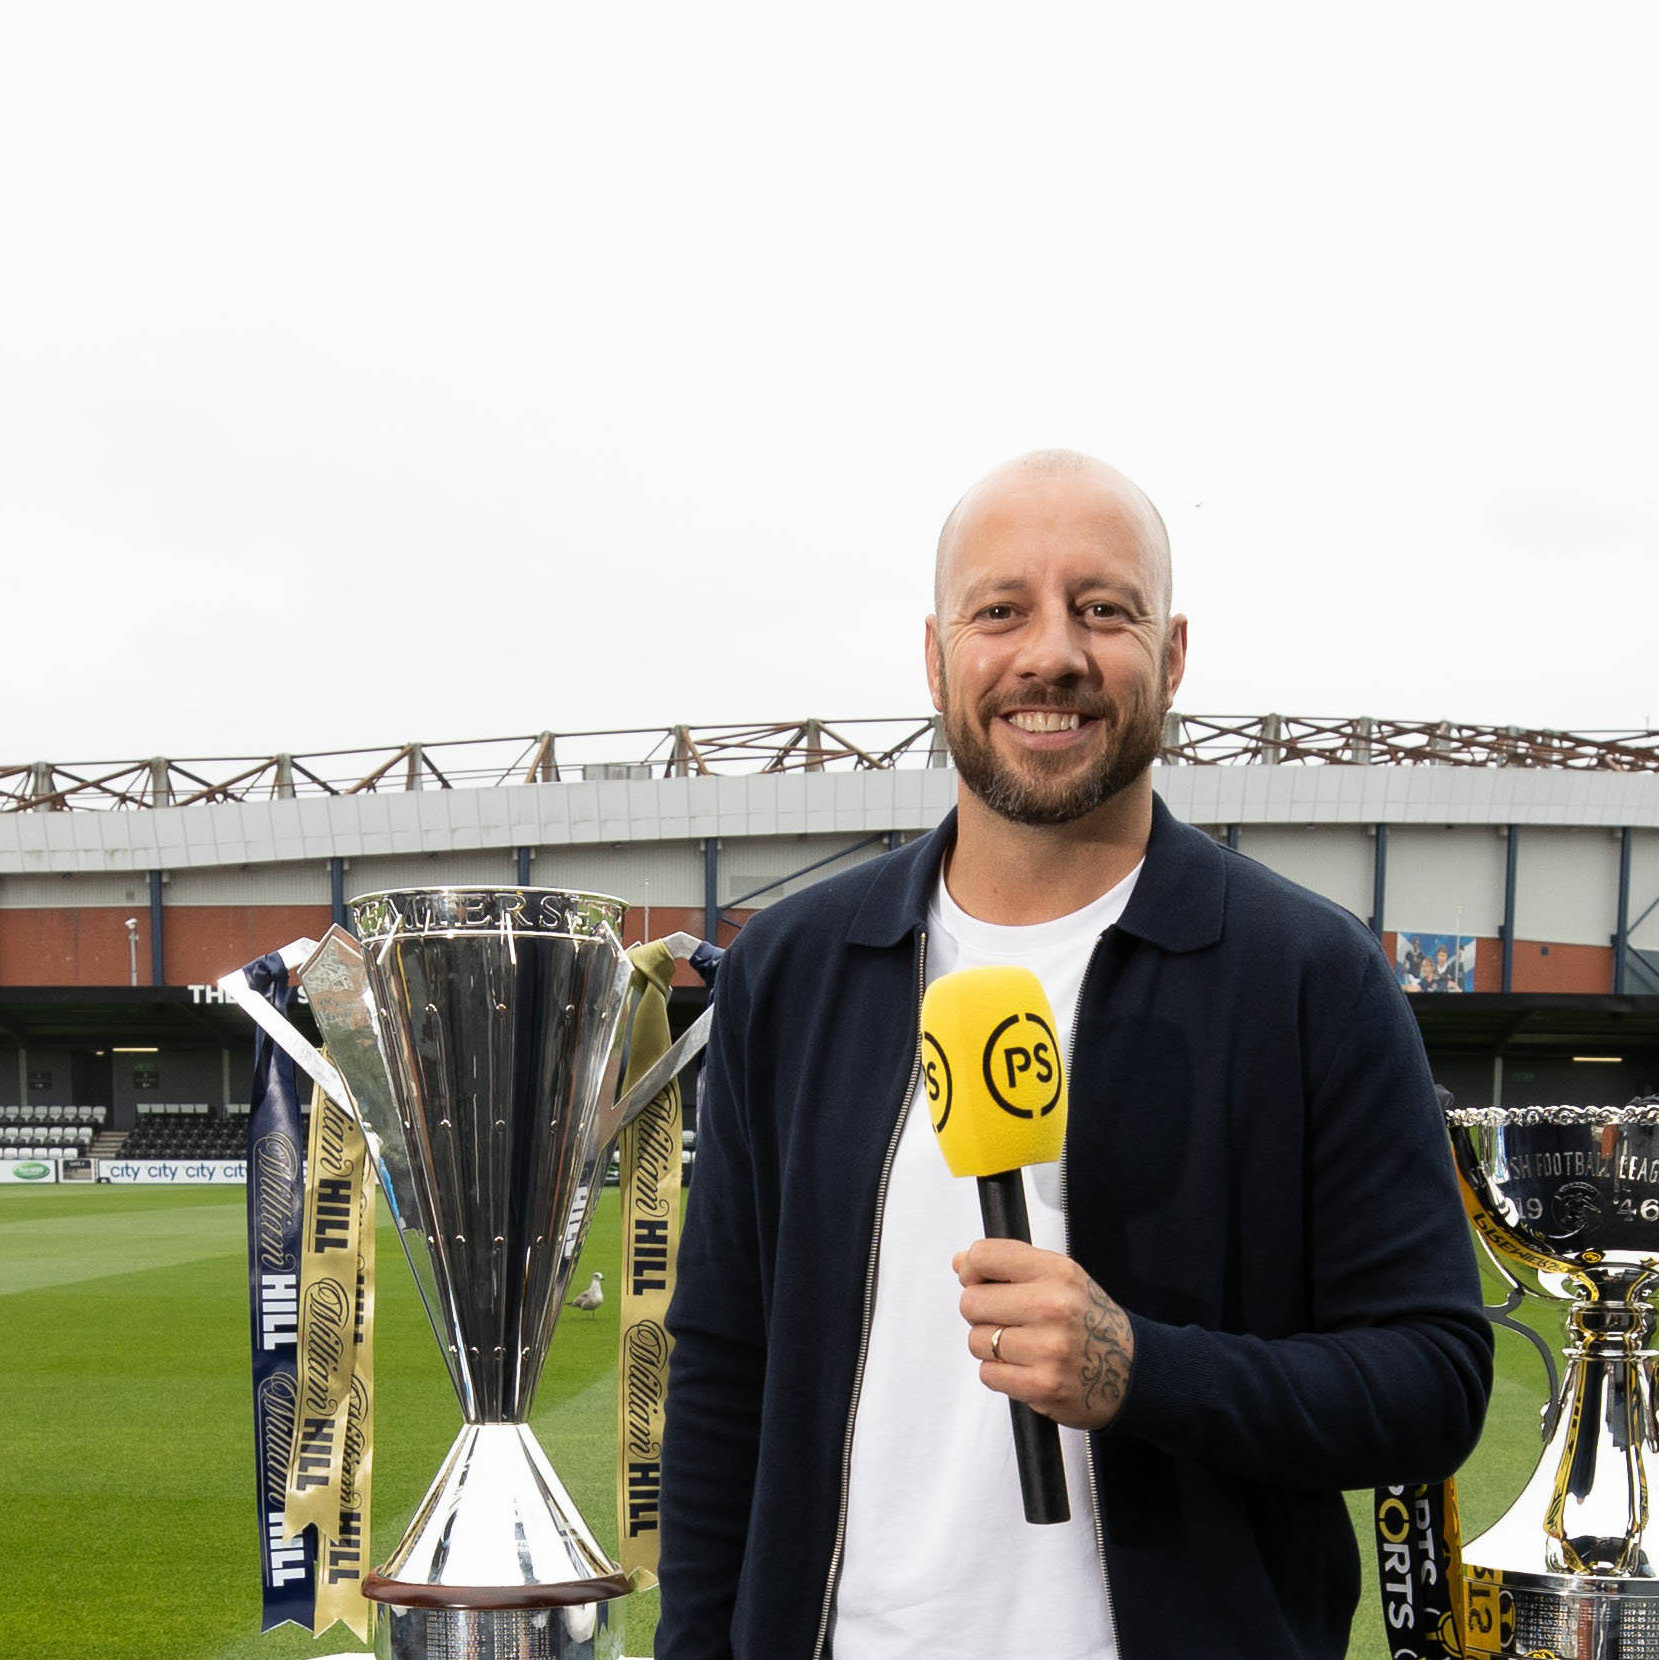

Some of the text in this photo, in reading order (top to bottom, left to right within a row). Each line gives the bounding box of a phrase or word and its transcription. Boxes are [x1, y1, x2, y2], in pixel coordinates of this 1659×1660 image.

[1004, 1042, 1053, 1088] PS
[110, 1164, 247, 1182] city city city cit
[1537, 1151, 1610, 1179] FOOTBALL
[253, 1131, 300, 1350] William HILL
[315, 1179, 352, 1254] HILL
[633, 1219, 668, 1296] HILL
[297, 1277, 349, 1491] William HILL
[624, 1319, 668, 1538] William HILL
[329, 1512, 362, 1585] HILL
